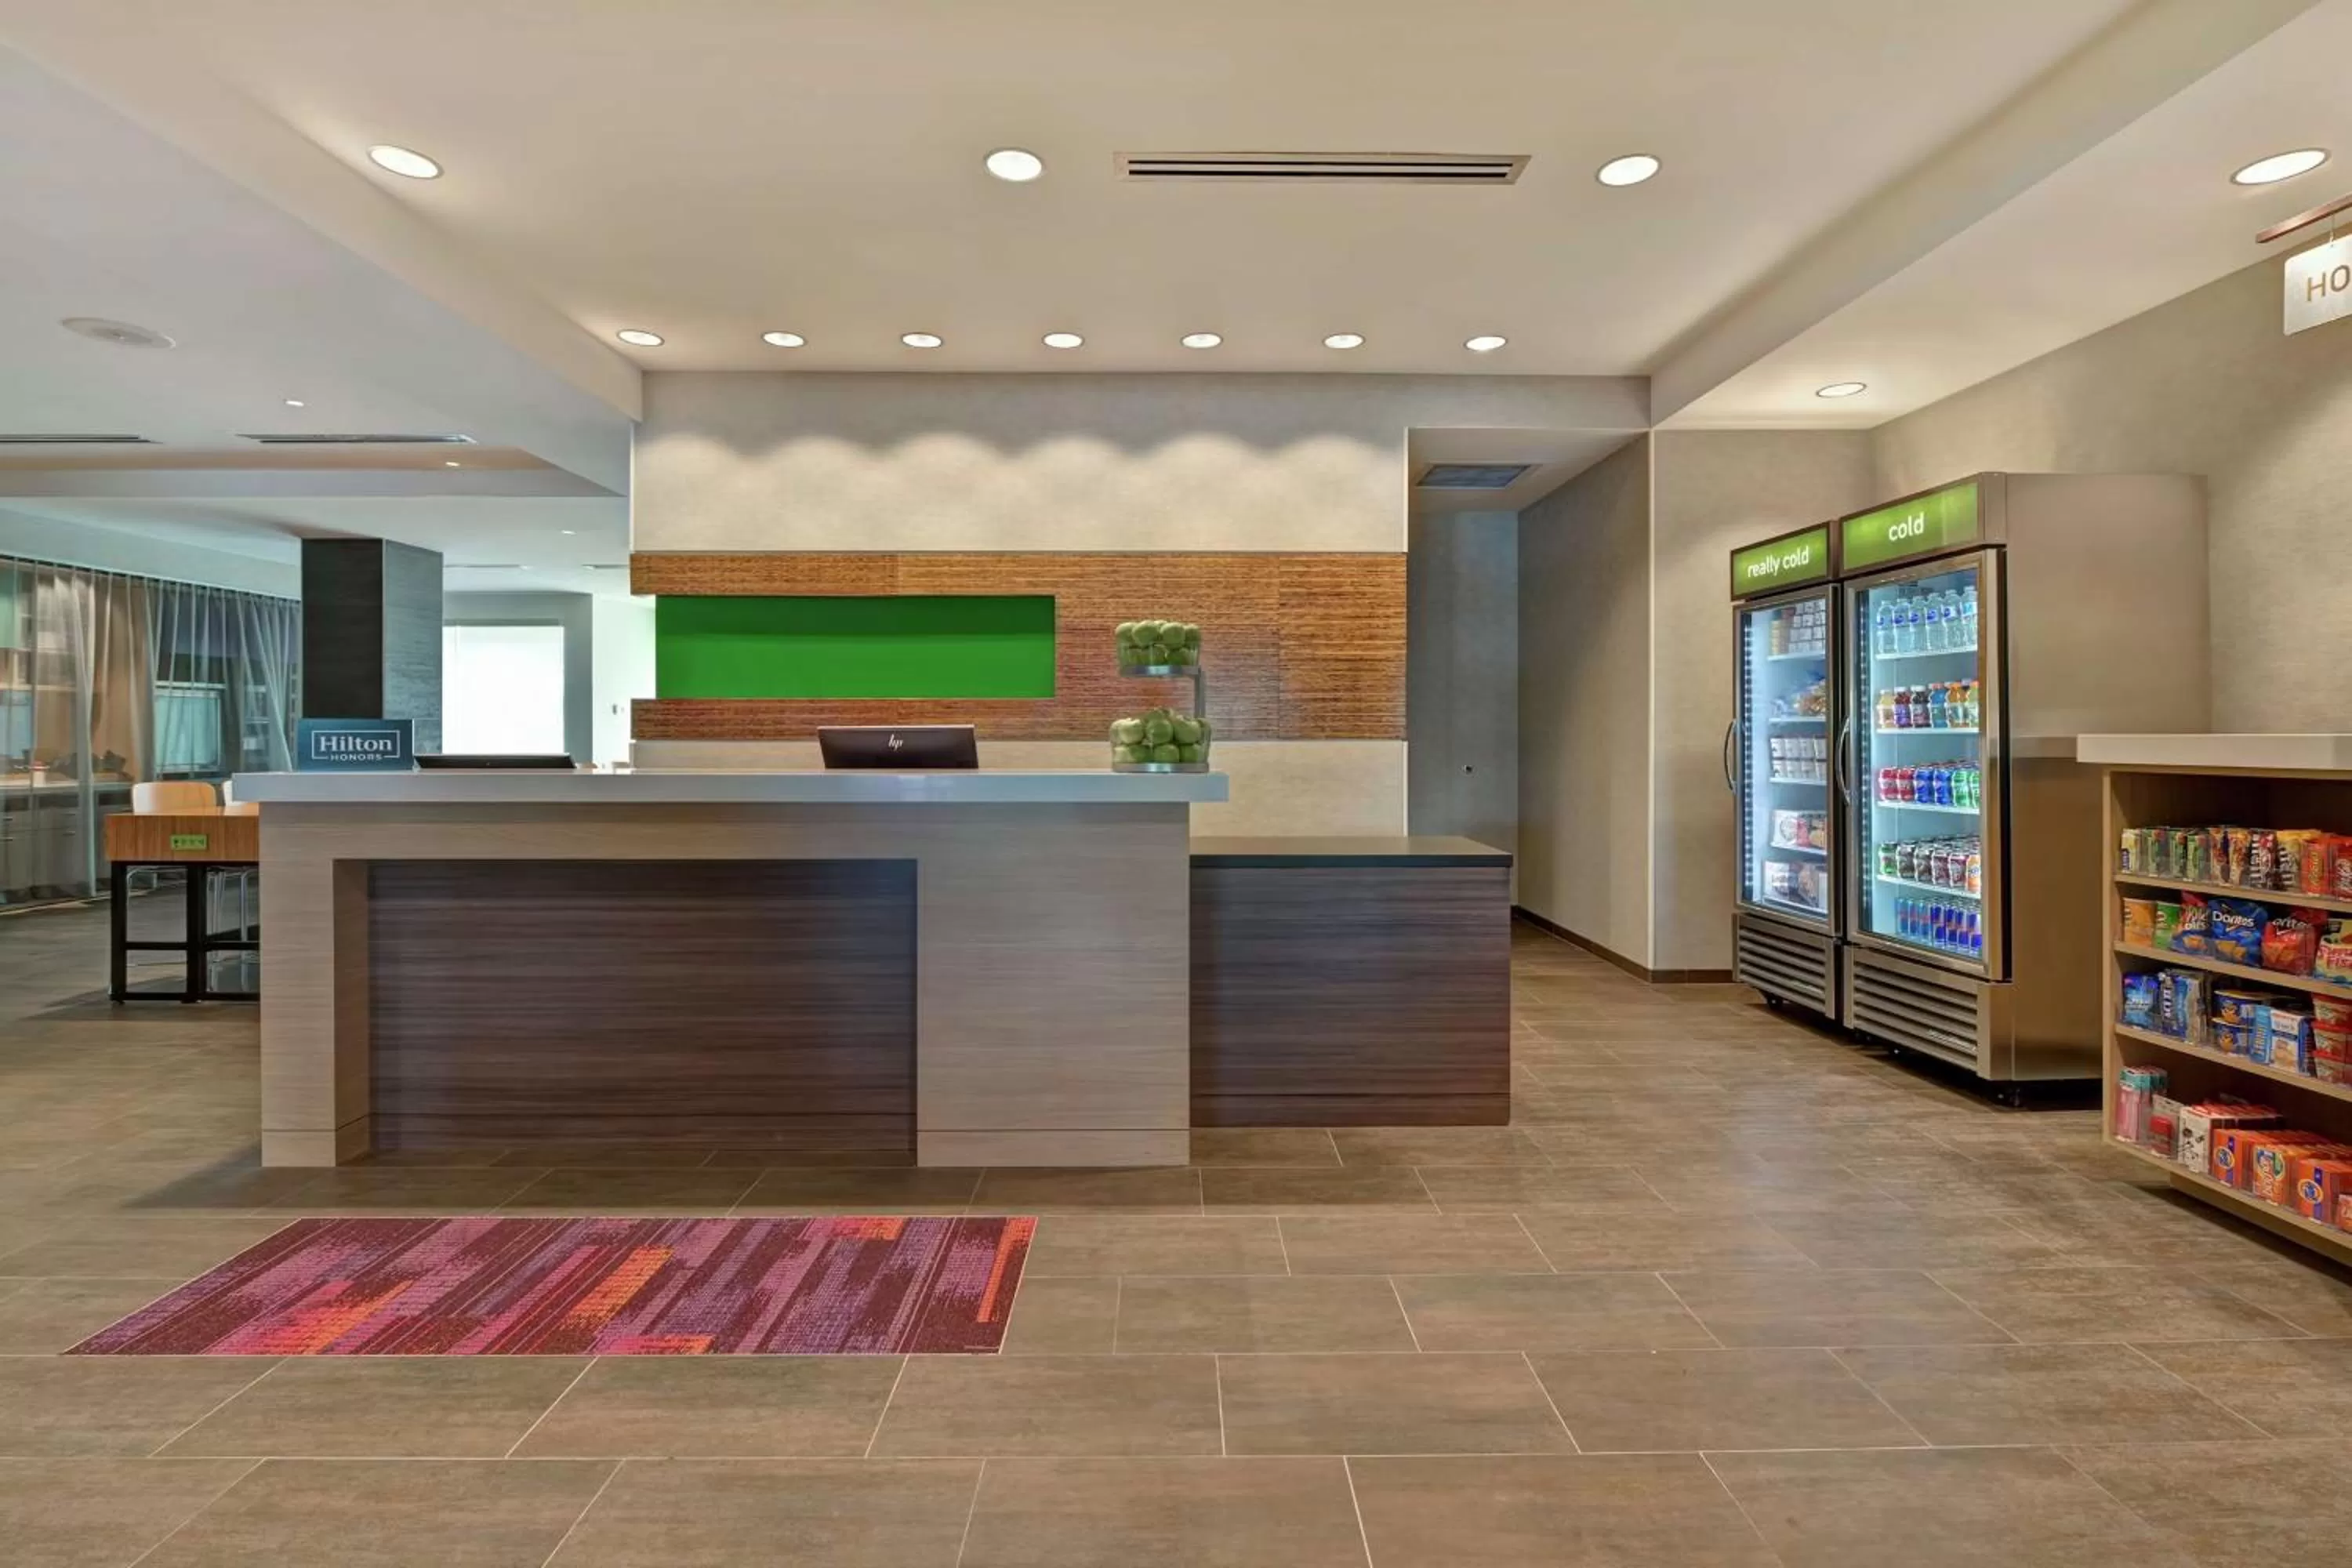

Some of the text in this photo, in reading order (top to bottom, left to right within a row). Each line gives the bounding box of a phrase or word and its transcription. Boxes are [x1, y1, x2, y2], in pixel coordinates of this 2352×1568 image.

[2306, 264, 2350, 302] HO
[1888, 513, 1925, 542] cold
[1747, 546, 1809, 578] really cold
[320, 735, 393, 752] Hilton
[2212, 910, 2255, 927] Doritos
